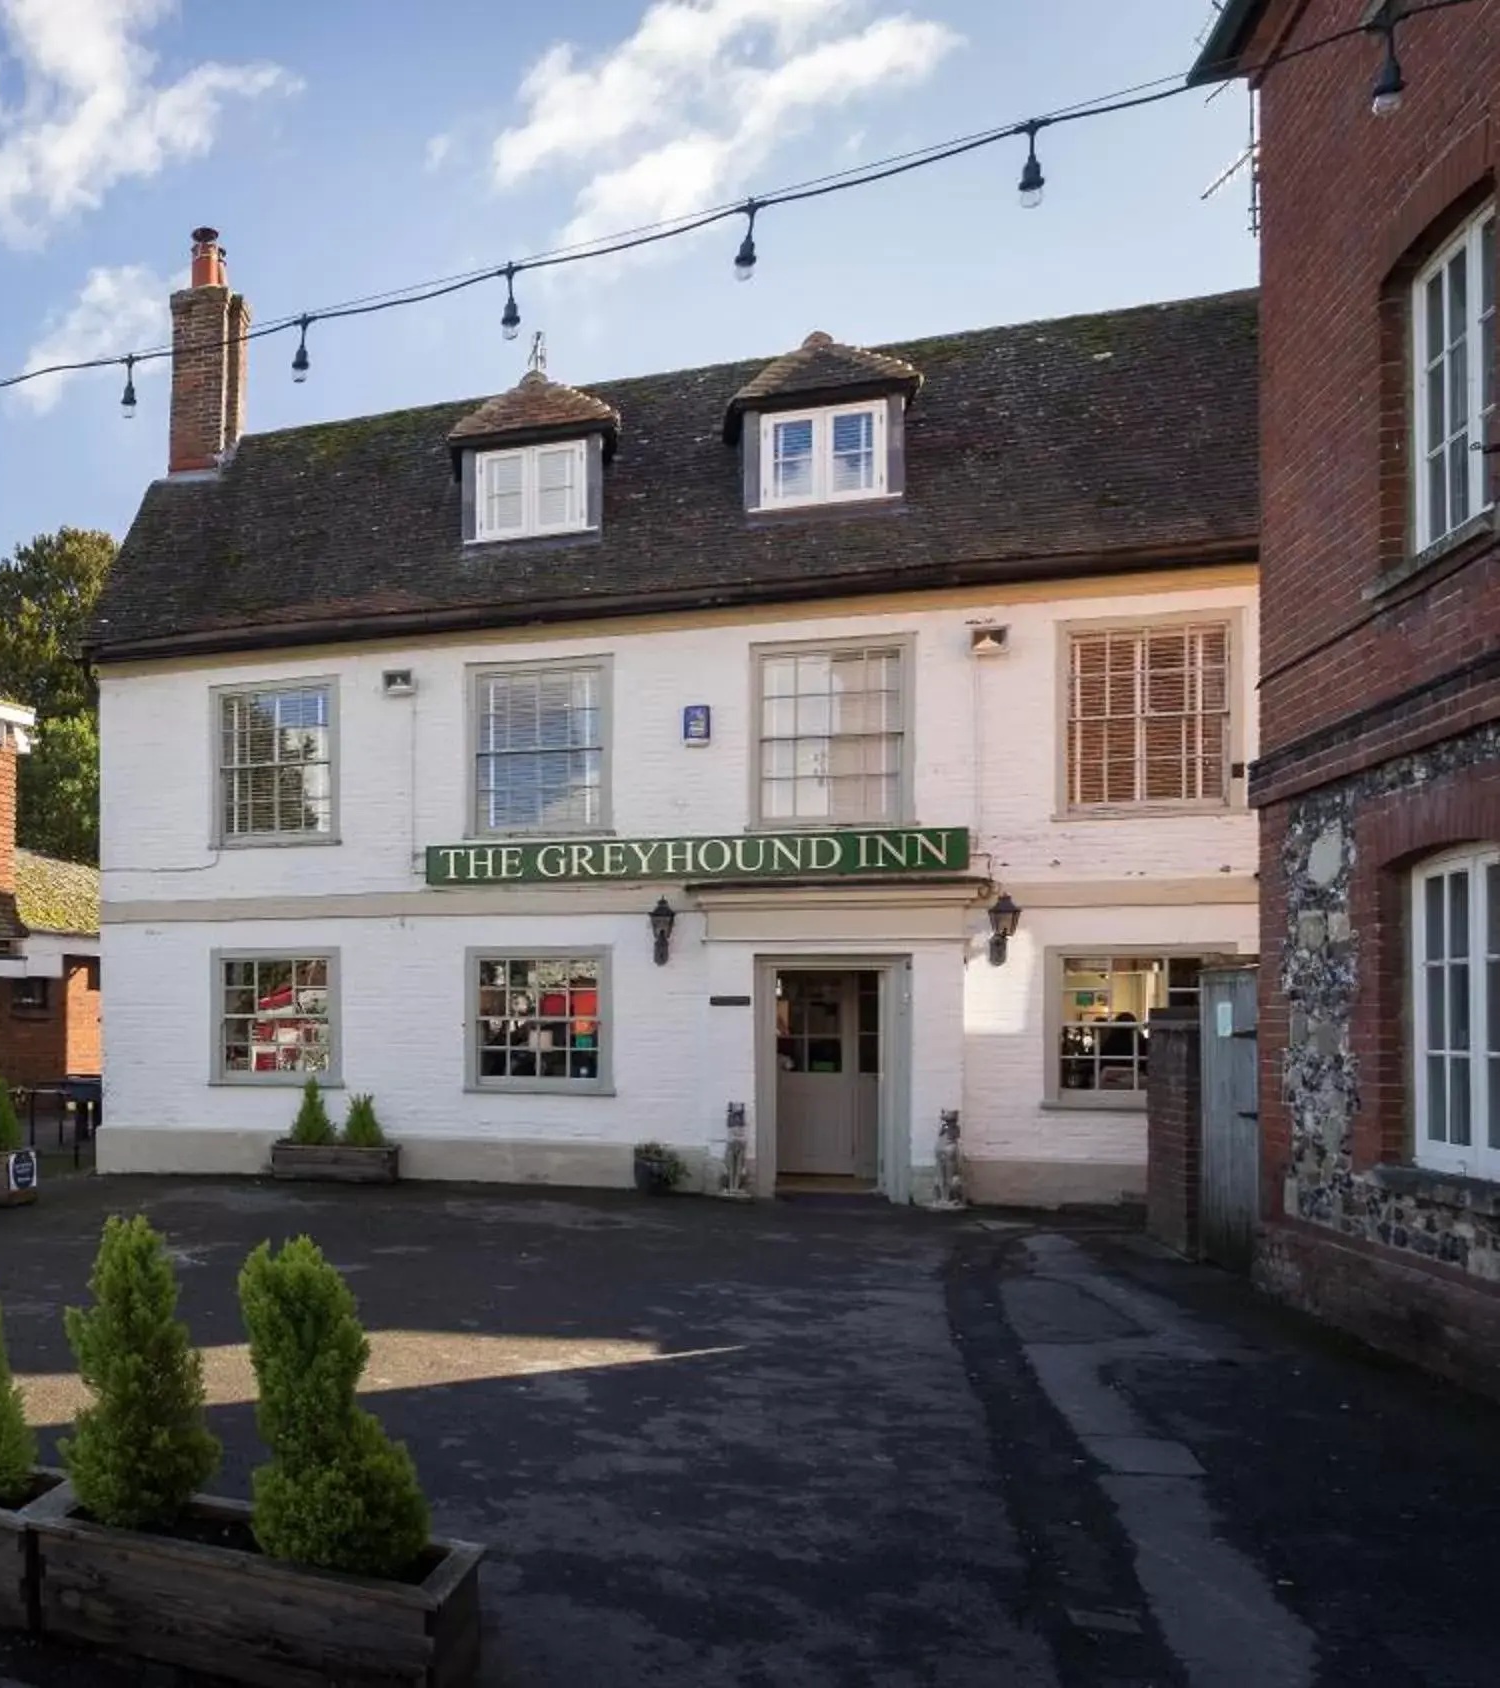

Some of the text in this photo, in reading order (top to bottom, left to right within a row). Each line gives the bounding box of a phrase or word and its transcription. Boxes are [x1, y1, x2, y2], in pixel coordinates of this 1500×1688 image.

[439, 831, 950, 880] THE GREYHOUND INN
